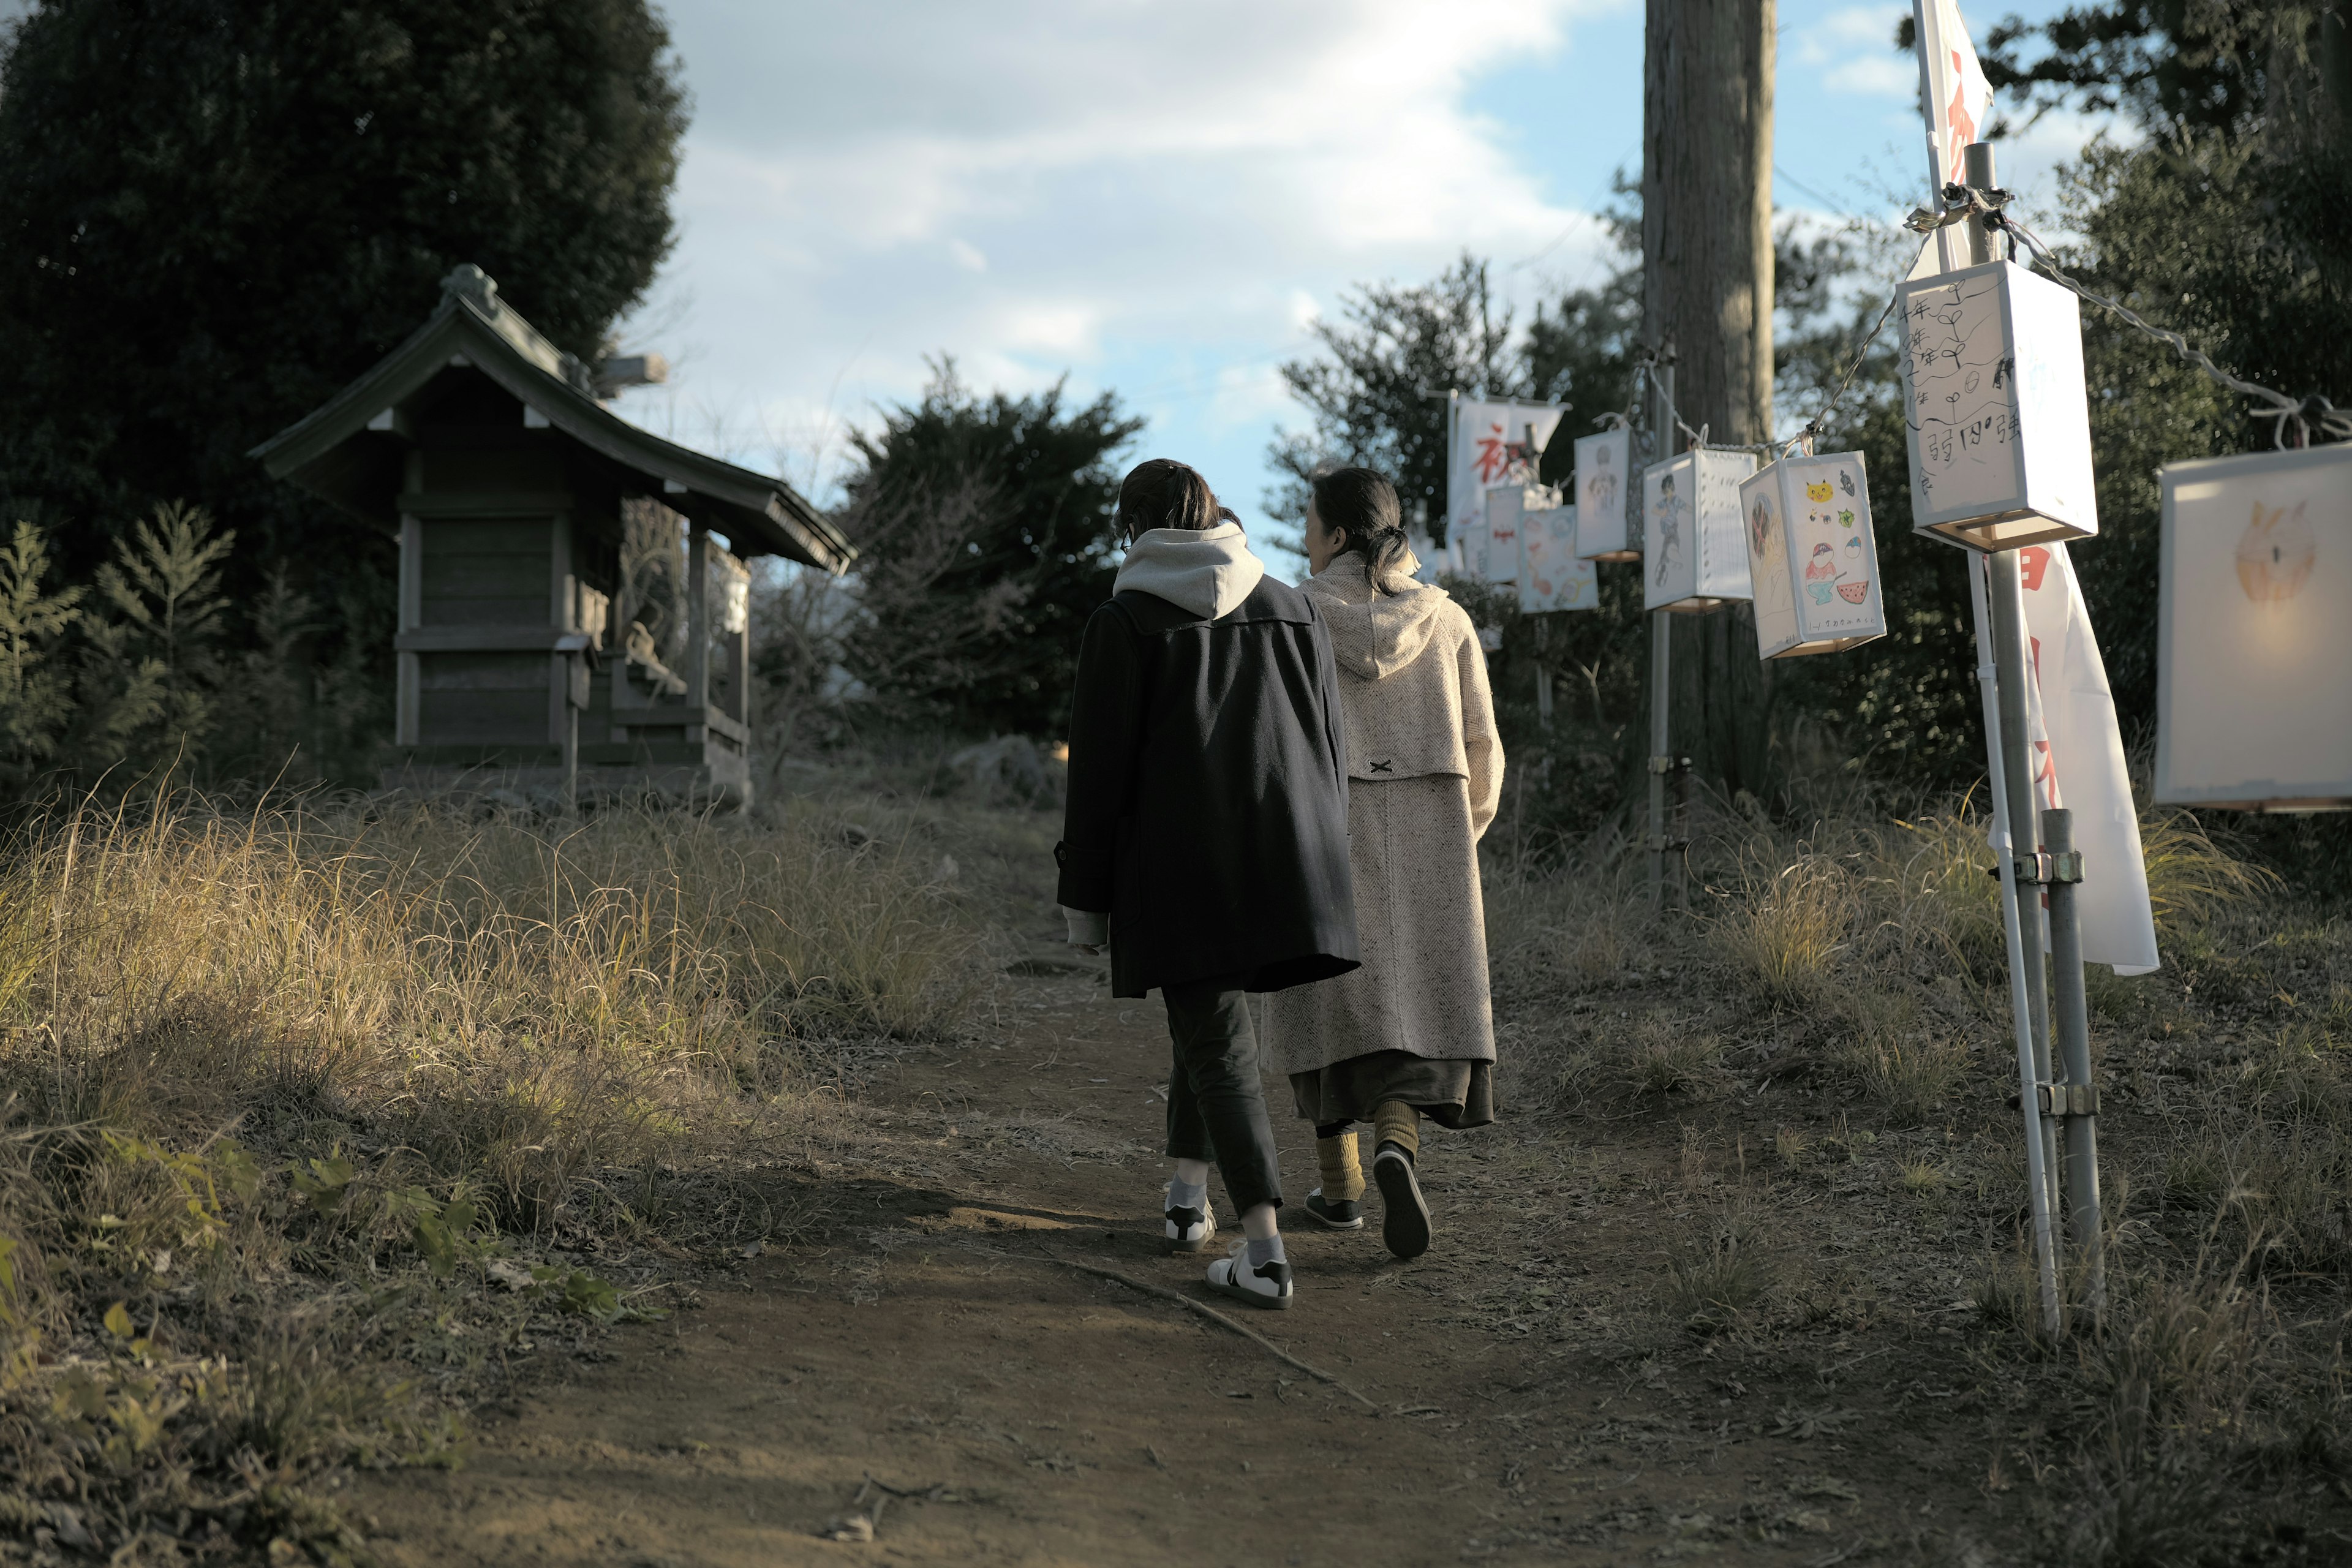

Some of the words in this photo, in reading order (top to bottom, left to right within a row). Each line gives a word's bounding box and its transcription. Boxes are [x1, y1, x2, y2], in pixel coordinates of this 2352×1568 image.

[1899, 298, 1931, 323] 4年
[1903, 352, 1939, 377] 2年
[1909, 391, 1930, 412] 1年
